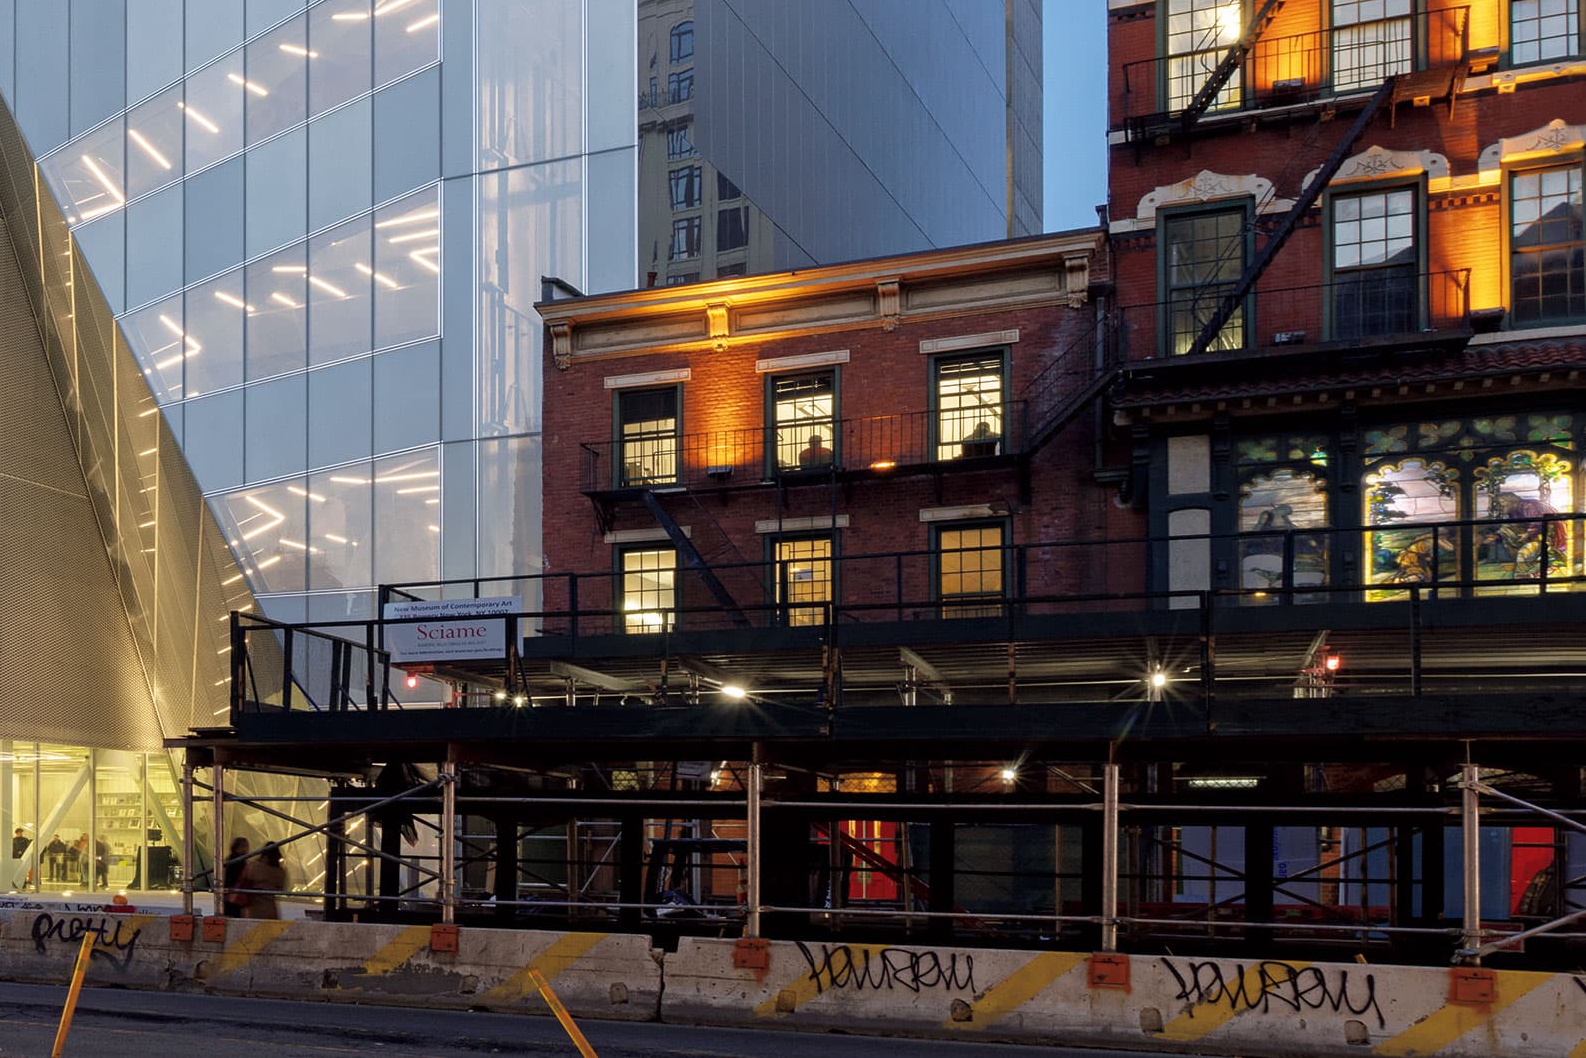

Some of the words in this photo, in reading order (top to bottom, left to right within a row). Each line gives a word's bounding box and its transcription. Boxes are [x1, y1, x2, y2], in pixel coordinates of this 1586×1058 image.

[411, 604, 440, 612] Museum
[450, 602, 500, 610] Contemporary
[417, 624, 487, 640] Sciame
